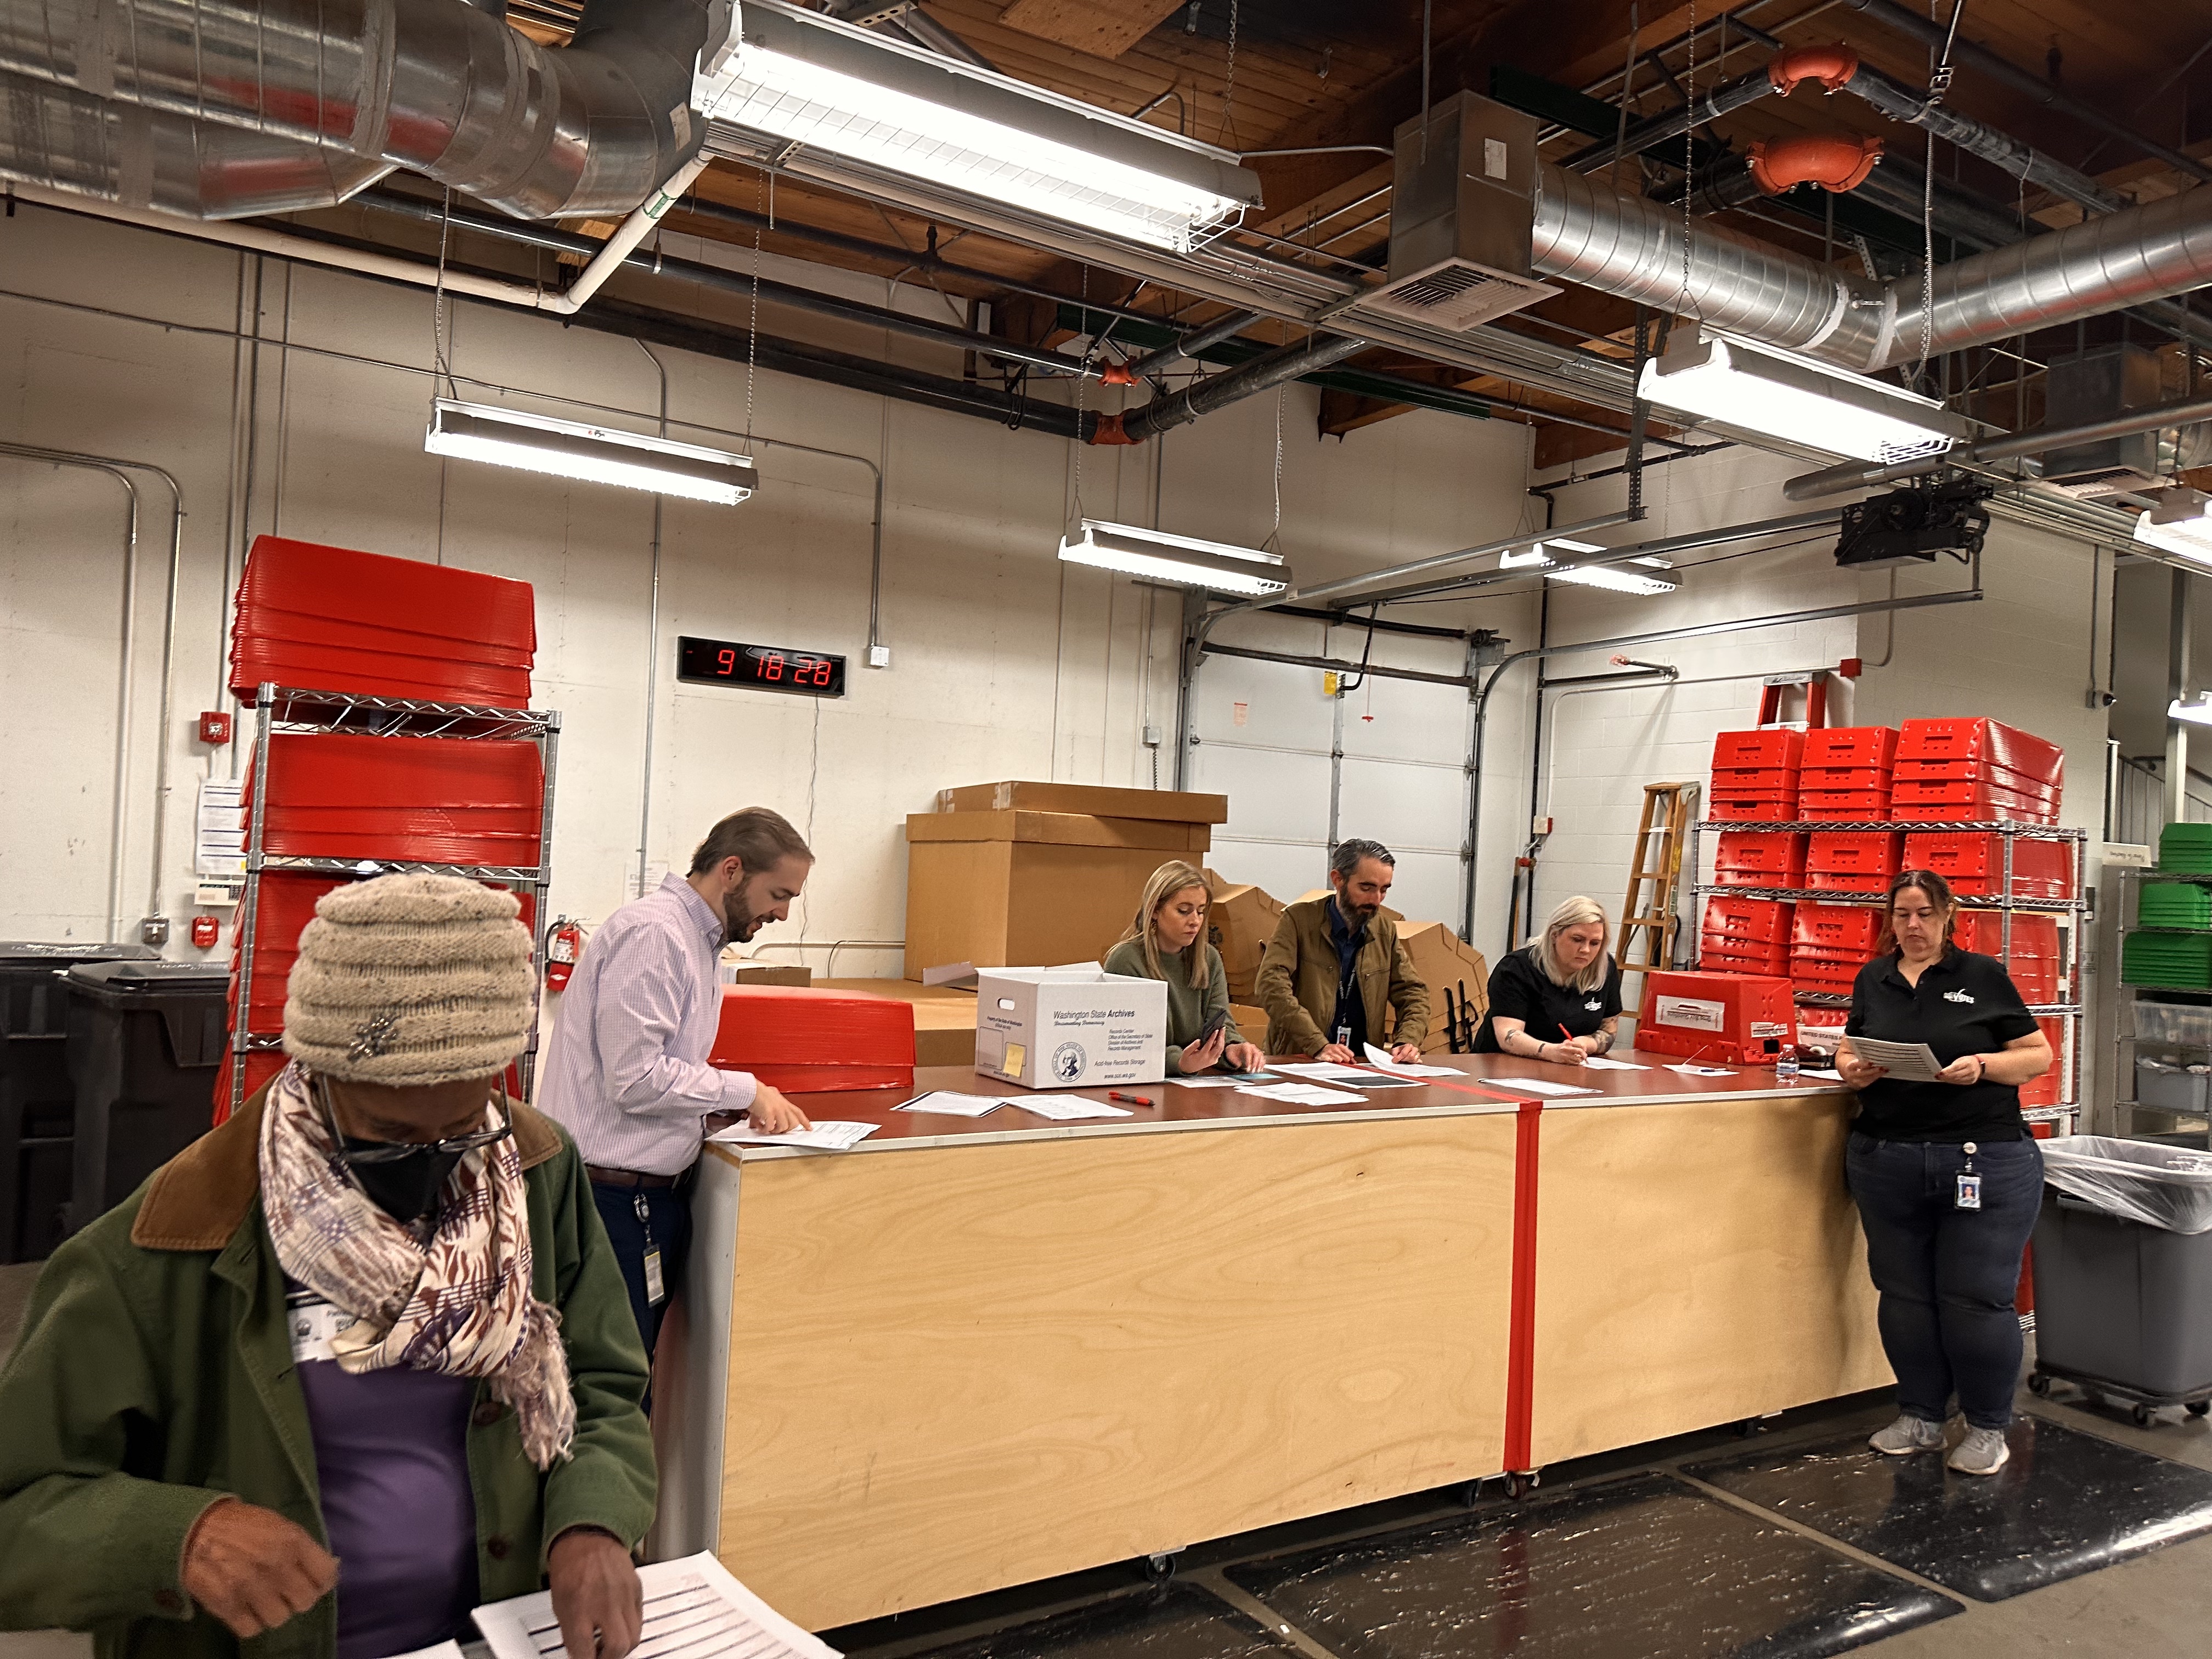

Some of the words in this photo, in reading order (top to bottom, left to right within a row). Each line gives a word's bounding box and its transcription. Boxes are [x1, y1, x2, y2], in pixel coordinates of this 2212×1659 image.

[717, 649, 735, 675] 9
[757, 655, 785, 680] 18
[794, 658, 832, 685] 28
[1053, 1010, 1090, 1020] Washington
[1090, 1010, 1107, 1018] State
[1107, 1009, 1135, 1018] Archives
